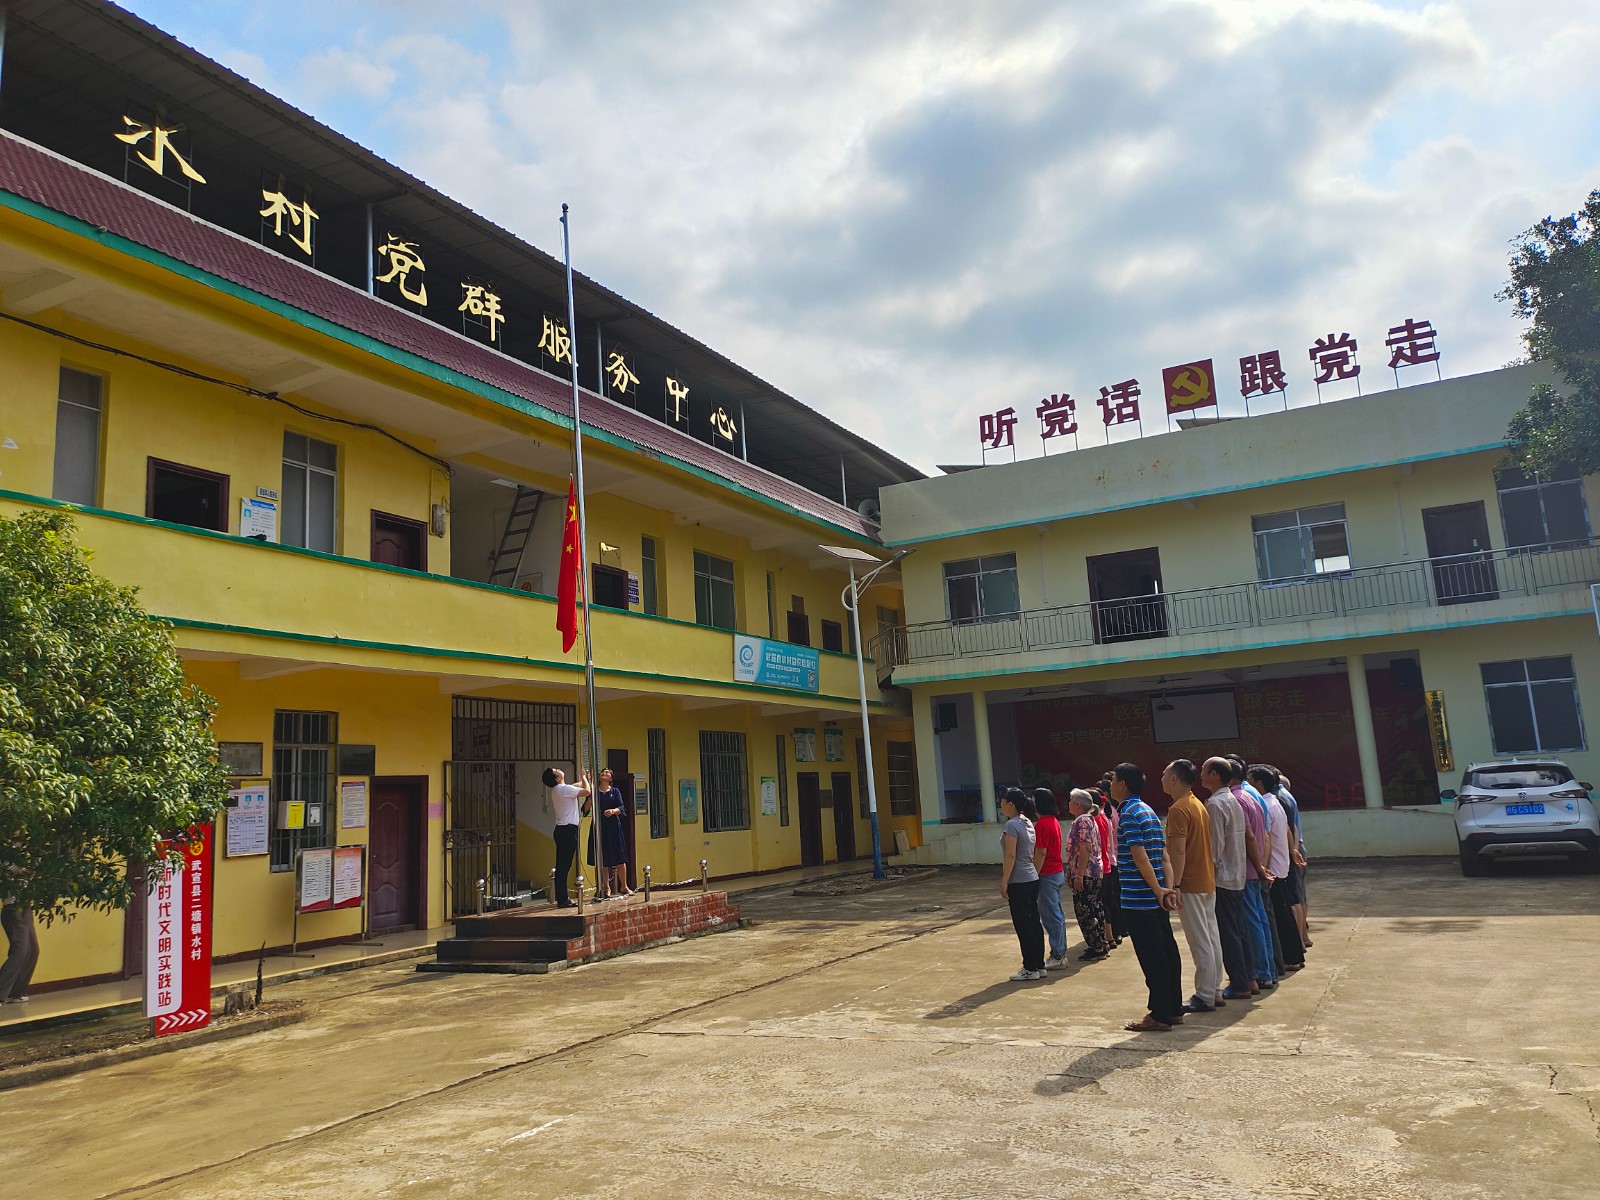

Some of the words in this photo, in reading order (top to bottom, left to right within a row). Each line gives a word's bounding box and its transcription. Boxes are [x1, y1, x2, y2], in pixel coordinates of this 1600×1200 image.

[114, 112, 738, 441] 水村党群服务中心
[979, 378, 1141, 449] 听党话
[1239, 318, 1441, 397] 跟党走
[157, 867, 172, 1008] 新时代文明实践站
[190, 859, 202, 961] 武宣县二塘镇水村
